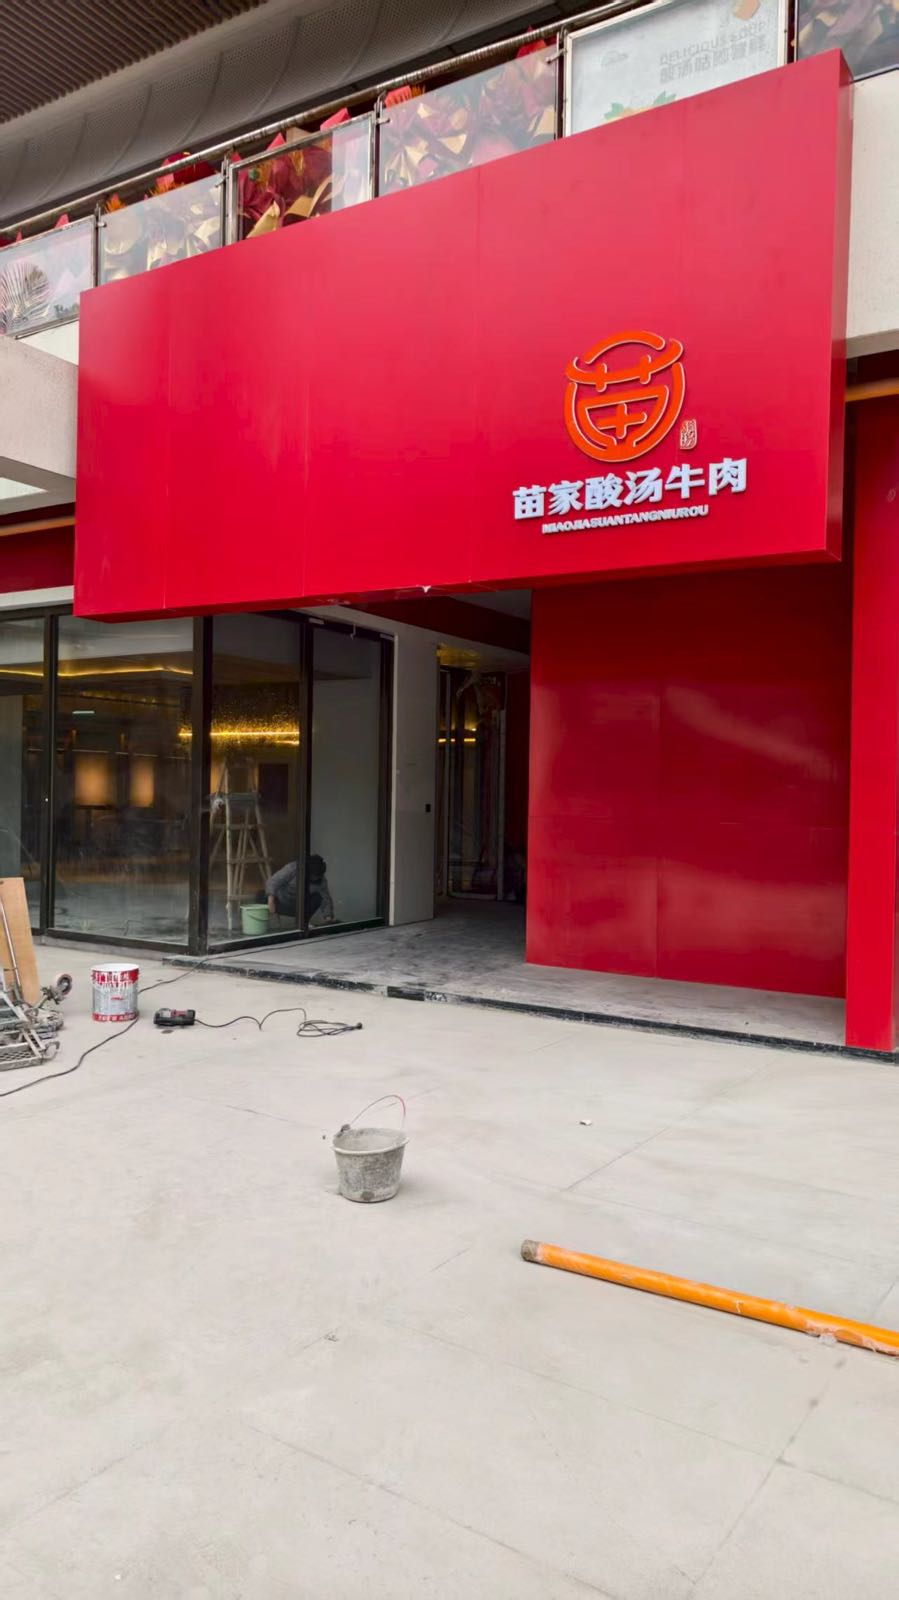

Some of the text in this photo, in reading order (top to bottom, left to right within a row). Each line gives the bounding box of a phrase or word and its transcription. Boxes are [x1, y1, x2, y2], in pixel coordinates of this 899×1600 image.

[512, 457, 748, 520] 苗家酸汤牛肉
[541, 504, 710, 535] MIAOJIASUANTANGNIUROU
